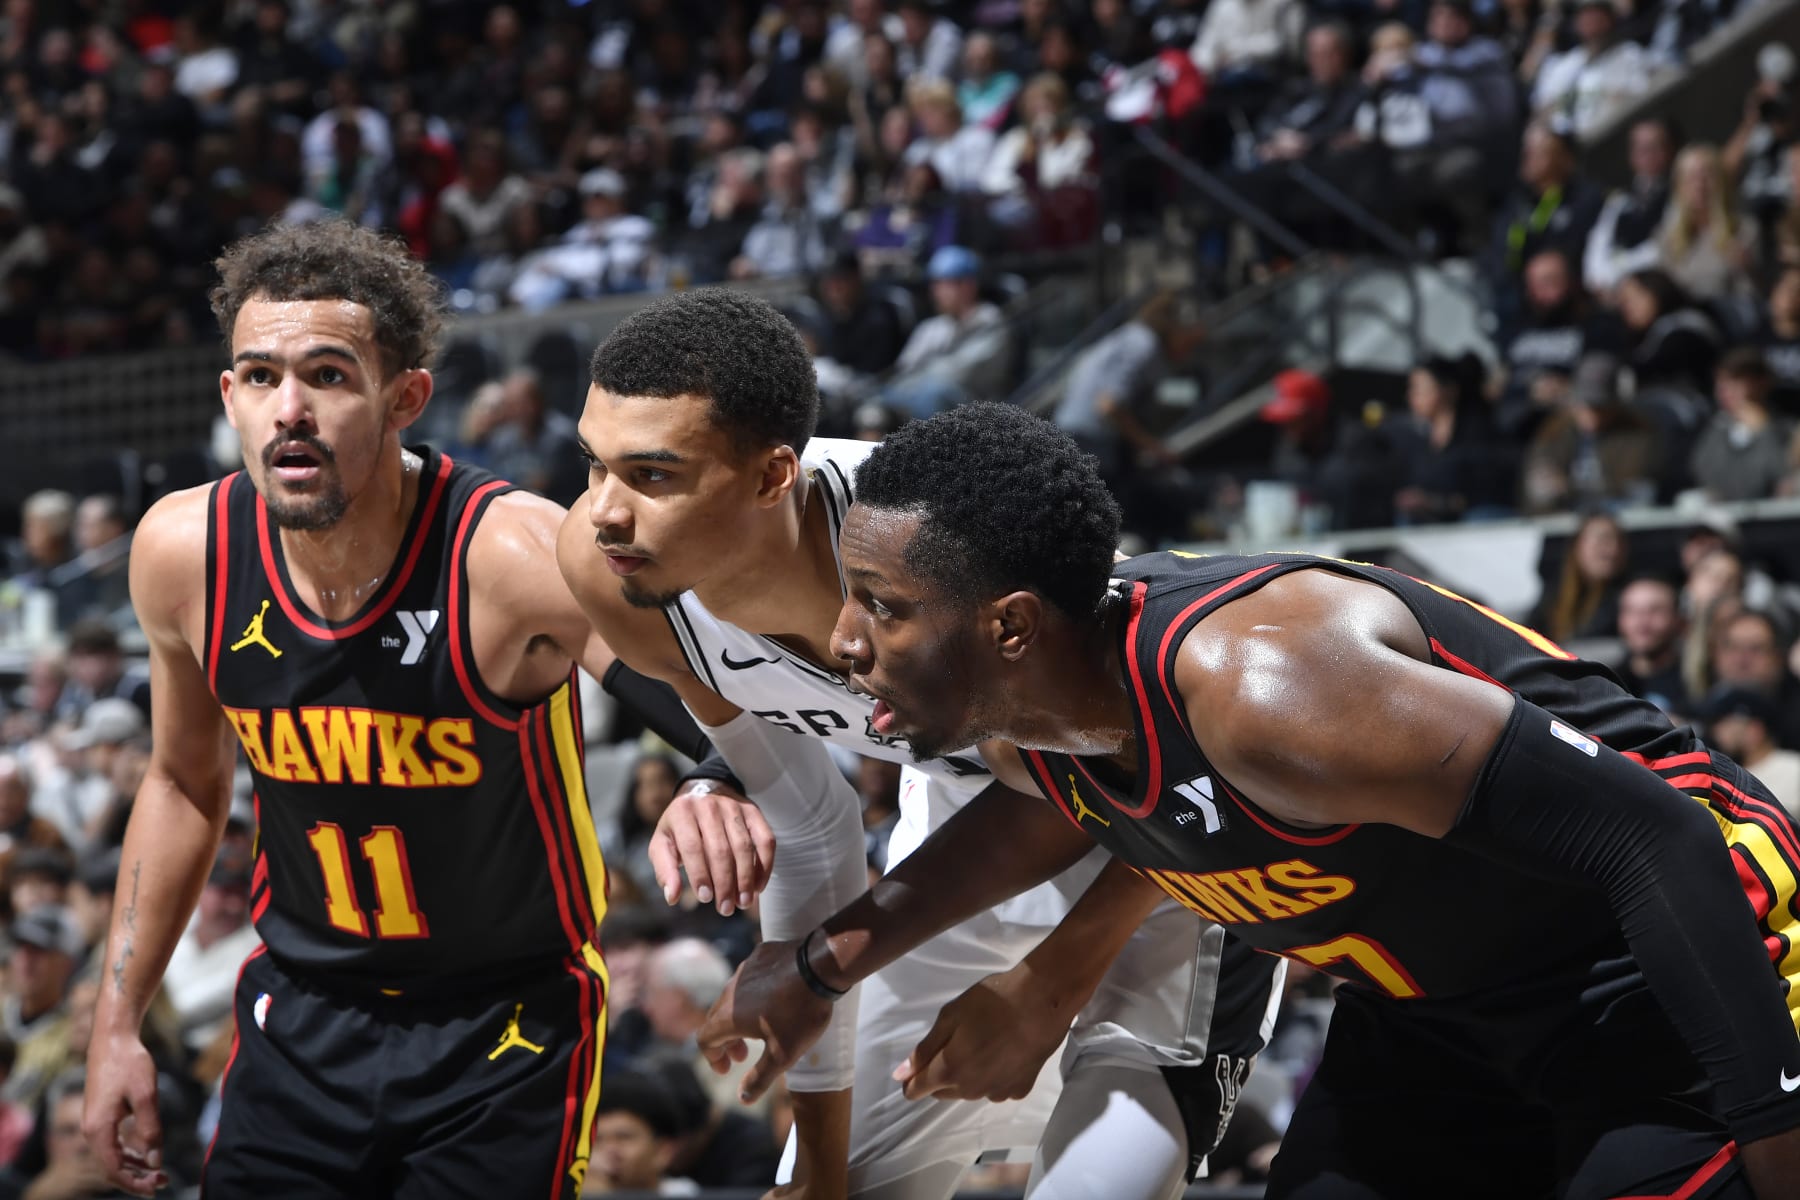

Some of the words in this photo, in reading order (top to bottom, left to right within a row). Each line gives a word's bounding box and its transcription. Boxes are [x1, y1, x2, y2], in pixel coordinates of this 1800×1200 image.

[381, 635, 400, 648] the
[396, 610, 440, 665] Y
[222, 706, 482, 787] HAWKS
[1173, 775, 1221, 834] Y
[1175, 811, 1198, 825] the
[307, 821, 430, 939] 11
[1122, 858, 1357, 924] AWKS
